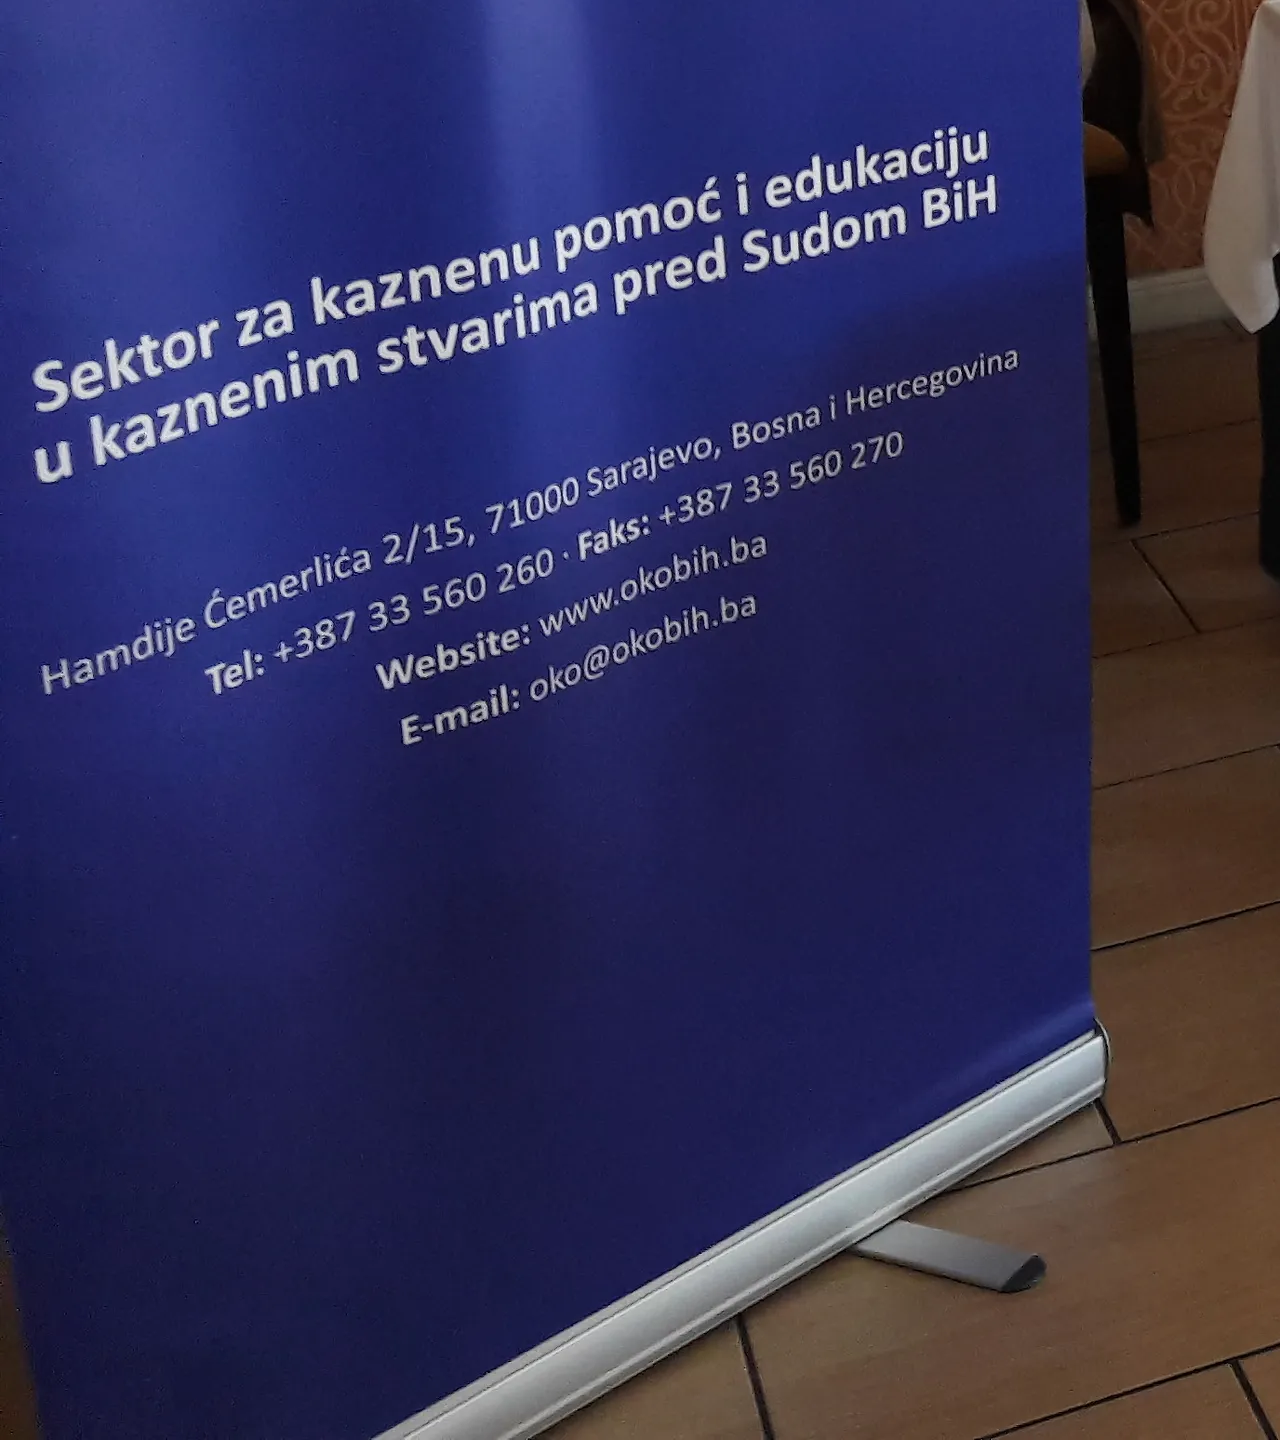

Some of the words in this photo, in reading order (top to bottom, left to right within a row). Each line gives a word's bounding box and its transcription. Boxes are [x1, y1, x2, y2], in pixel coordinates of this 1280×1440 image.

[32, 319, 219, 412] Sektor
[236, 300, 293, 346] za
[311, 237, 540, 325] kaznenu
[555, 176, 721, 273] pomoć
[736, 172, 748, 215] i
[765, 126, 988, 208] edukaciju
[34, 441, 73, 483] u
[89, 349, 359, 466] kaznenim
[377, 281, 597, 374] stvarima
[613, 235, 726, 315] pred
[743, 204, 906, 272] Sudom
[923, 174, 996, 228] BiH
[41, 618, 197, 694] Hamdije
[204, 546, 371, 628] Ćemerlića
[383, 516, 474, 564] 2/15,
[486, 477, 579, 533] 71000
[587, 438, 720, 497] Sarajevo,
[732, 407, 820, 449] Bosna
[829, 395, 836, 420] i
[847, 350, 1018, 415] Hercegovina
[204, 649, 264, 695] Tel:
[274, 610, 355, 662] +387
[368, 594, 410, 631] 33
[423, 572, 486, 615] 560
[497, 548, 553, 593] 260
[578, 515, 650, 561] Faks:
[659, 482, 732, 525] +387
[744, 470, 779, 502] 33
[791, 450, 842, 489] 560
[852, 432, 902, 469] 270
[376, 625, 530, 689] Website:
[539, 536, 766, 636] www.okobih.ba
[401, 684, 520, 745] E-mail:
[530, 596, 756, 700] oko@okobih.ba
